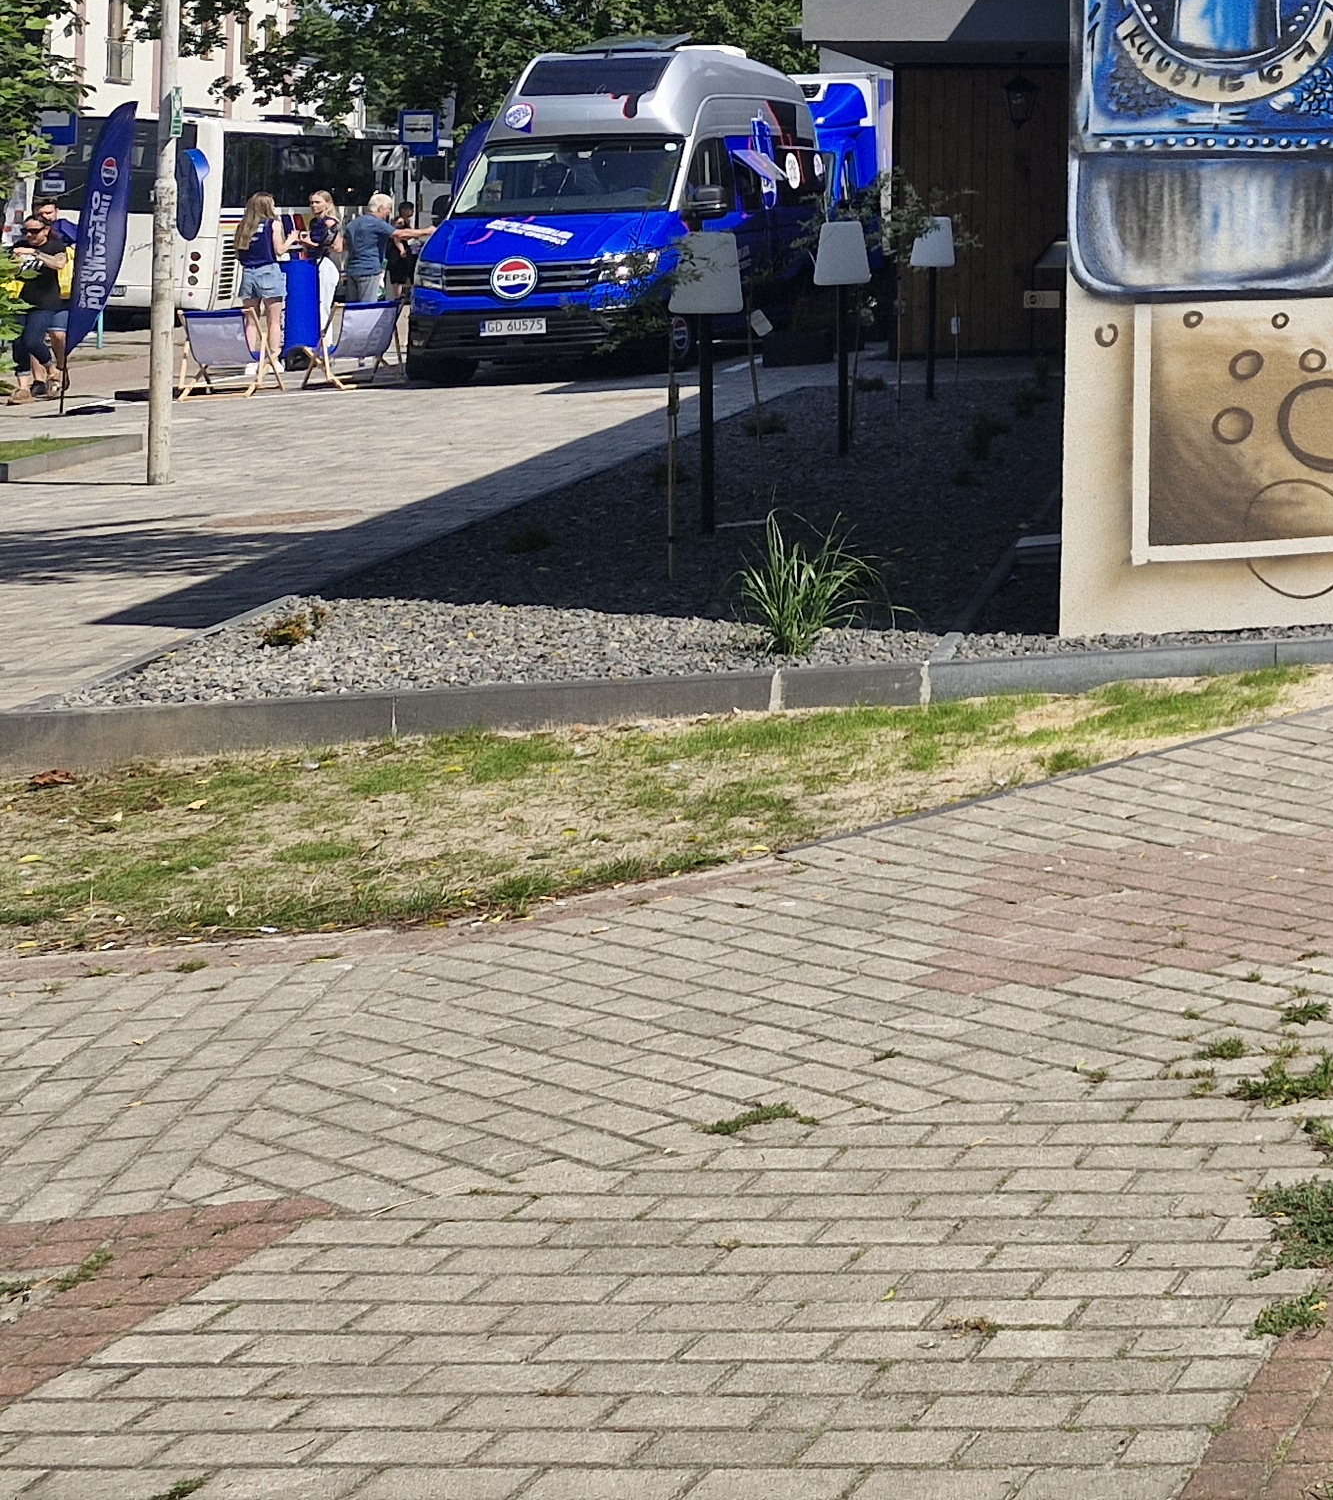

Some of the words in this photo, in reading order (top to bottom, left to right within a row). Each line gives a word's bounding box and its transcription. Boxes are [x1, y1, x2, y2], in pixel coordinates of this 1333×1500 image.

[378, 148, 396, 166] 7
[496, 273, 532, 282] PEPSI
[84, 284, 106, 311] PO
[487, 321, 503, 333] GD
[507, 318, 544, 332] 6U575
